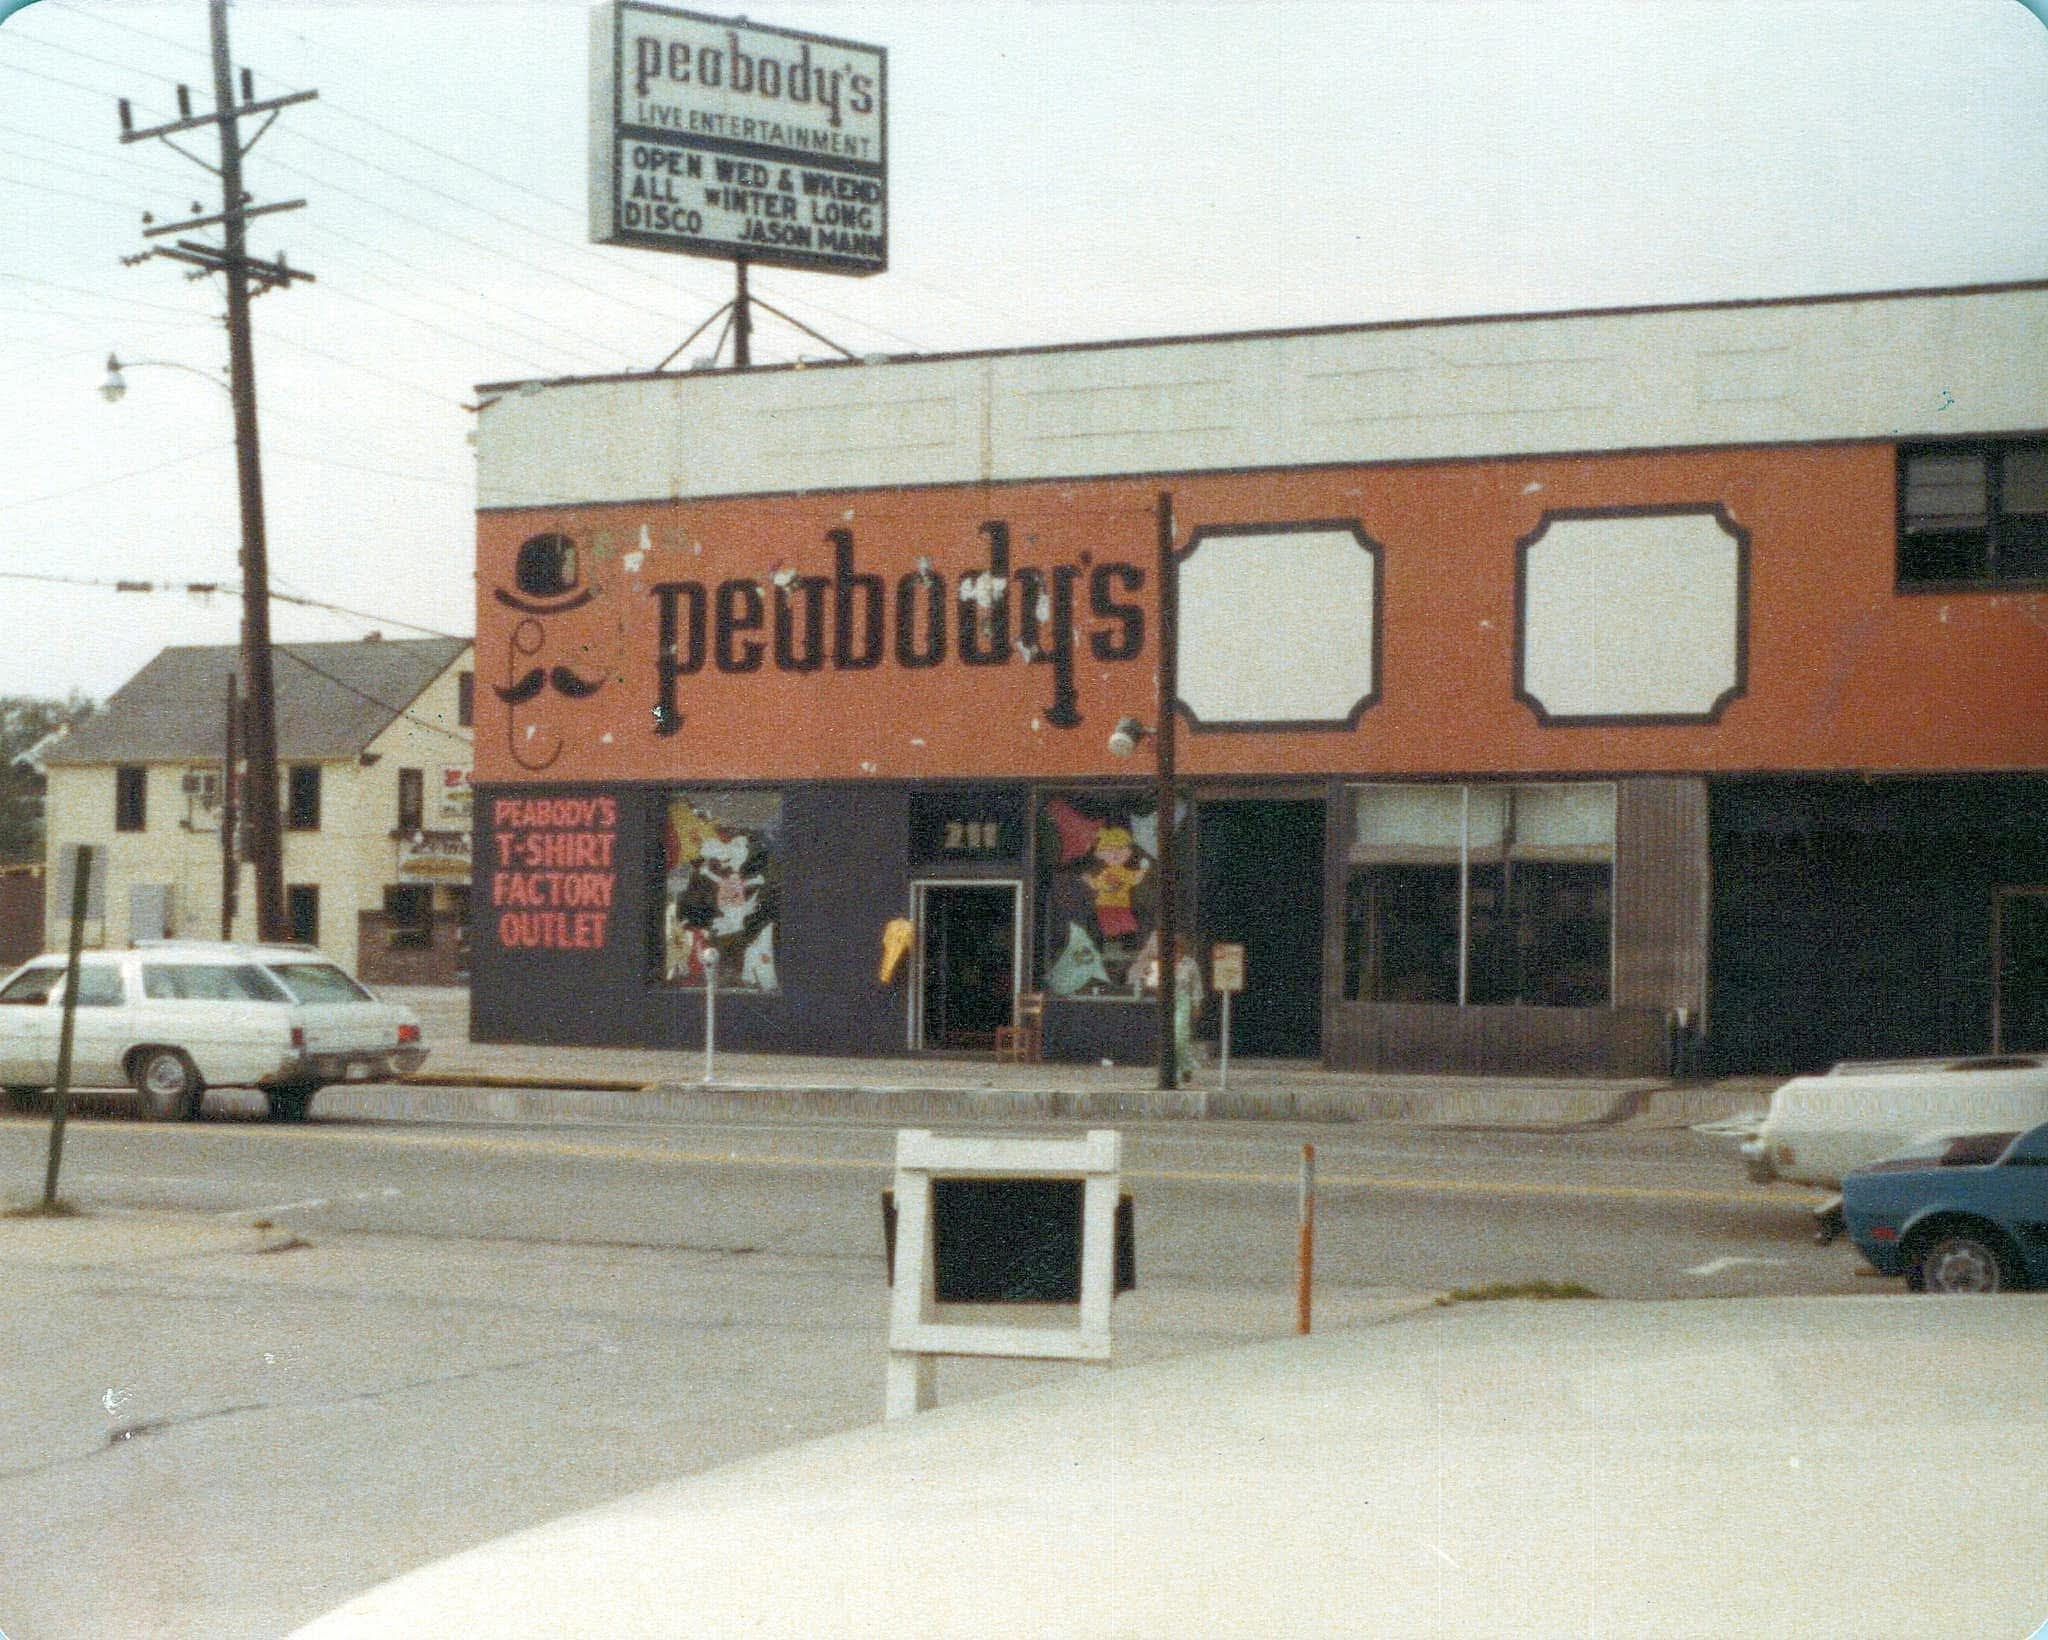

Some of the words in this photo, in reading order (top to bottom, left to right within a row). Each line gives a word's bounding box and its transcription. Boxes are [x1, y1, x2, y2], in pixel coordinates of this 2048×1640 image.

[634, 29, 875, 128] peabody's
[637, 103, 683, 126] LIVE
[689, 109, 870, 158] ENTERTAINMENT
[632, 145, 702, 178] OPEN
[715, 158, 769, 189] WED
[778, 168, 795, 192] &
[625, 201, 702, 233] DISCO
[738, 219, 811, 246] JASON
[632, 174, 679, 202] ALL
[811, 201, 874, 231] LONG
[650, 520, 1146, 738] peabody's
[494, 795, 617, 827] PEABODY'S
[495, 832, 617, 867] T-SHIRT
[494, 872, 617, 908] FACTORY
[500, 911, 607, 949] OUTLET
